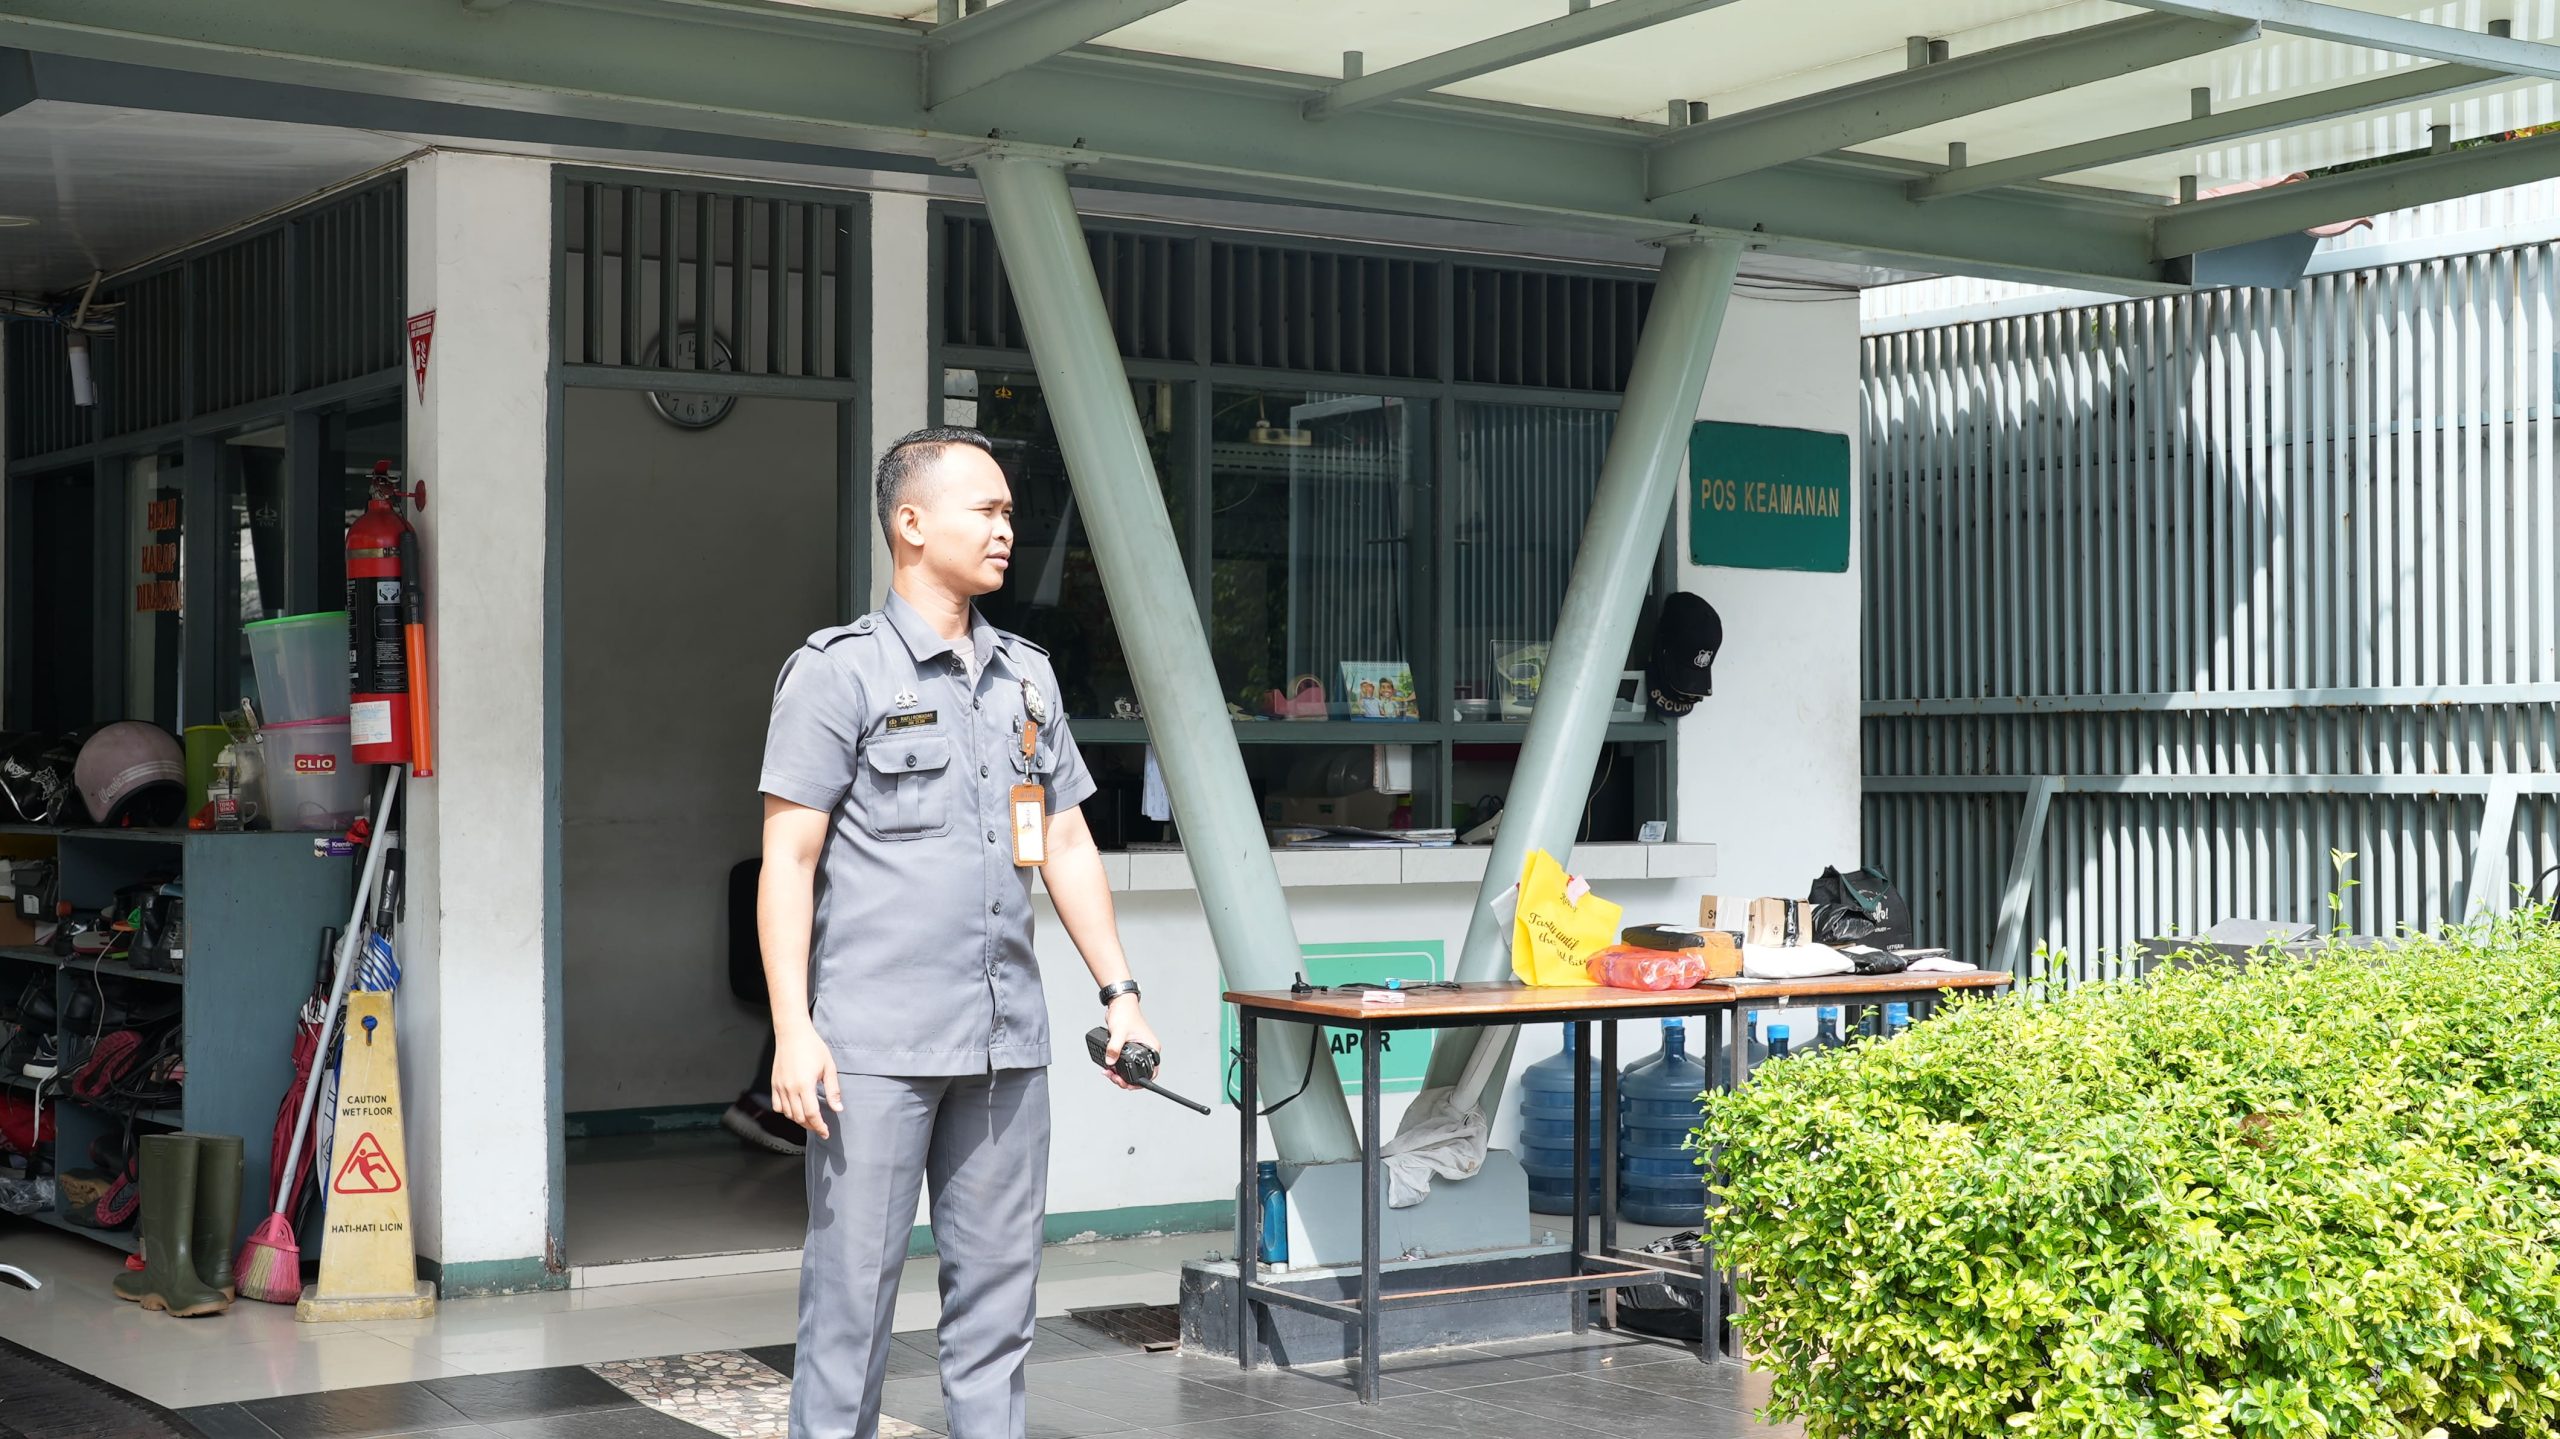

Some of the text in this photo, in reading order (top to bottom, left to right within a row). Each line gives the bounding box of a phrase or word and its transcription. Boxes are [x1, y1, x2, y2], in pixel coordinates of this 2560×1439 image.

[686, 403, 695, 416] 6
[1701, 478, 1839, 518] POS KEAMANAN
[296, 759, 333, 769] CLIO
[1528, 912, 1580, 951] Tasty until
[347, 1095, 387, 1104] CAUTION
[342, 1107, 393, 1116] WET FLOOR
[331, 1222, 403, 1234] HATI-HATI LICIN
